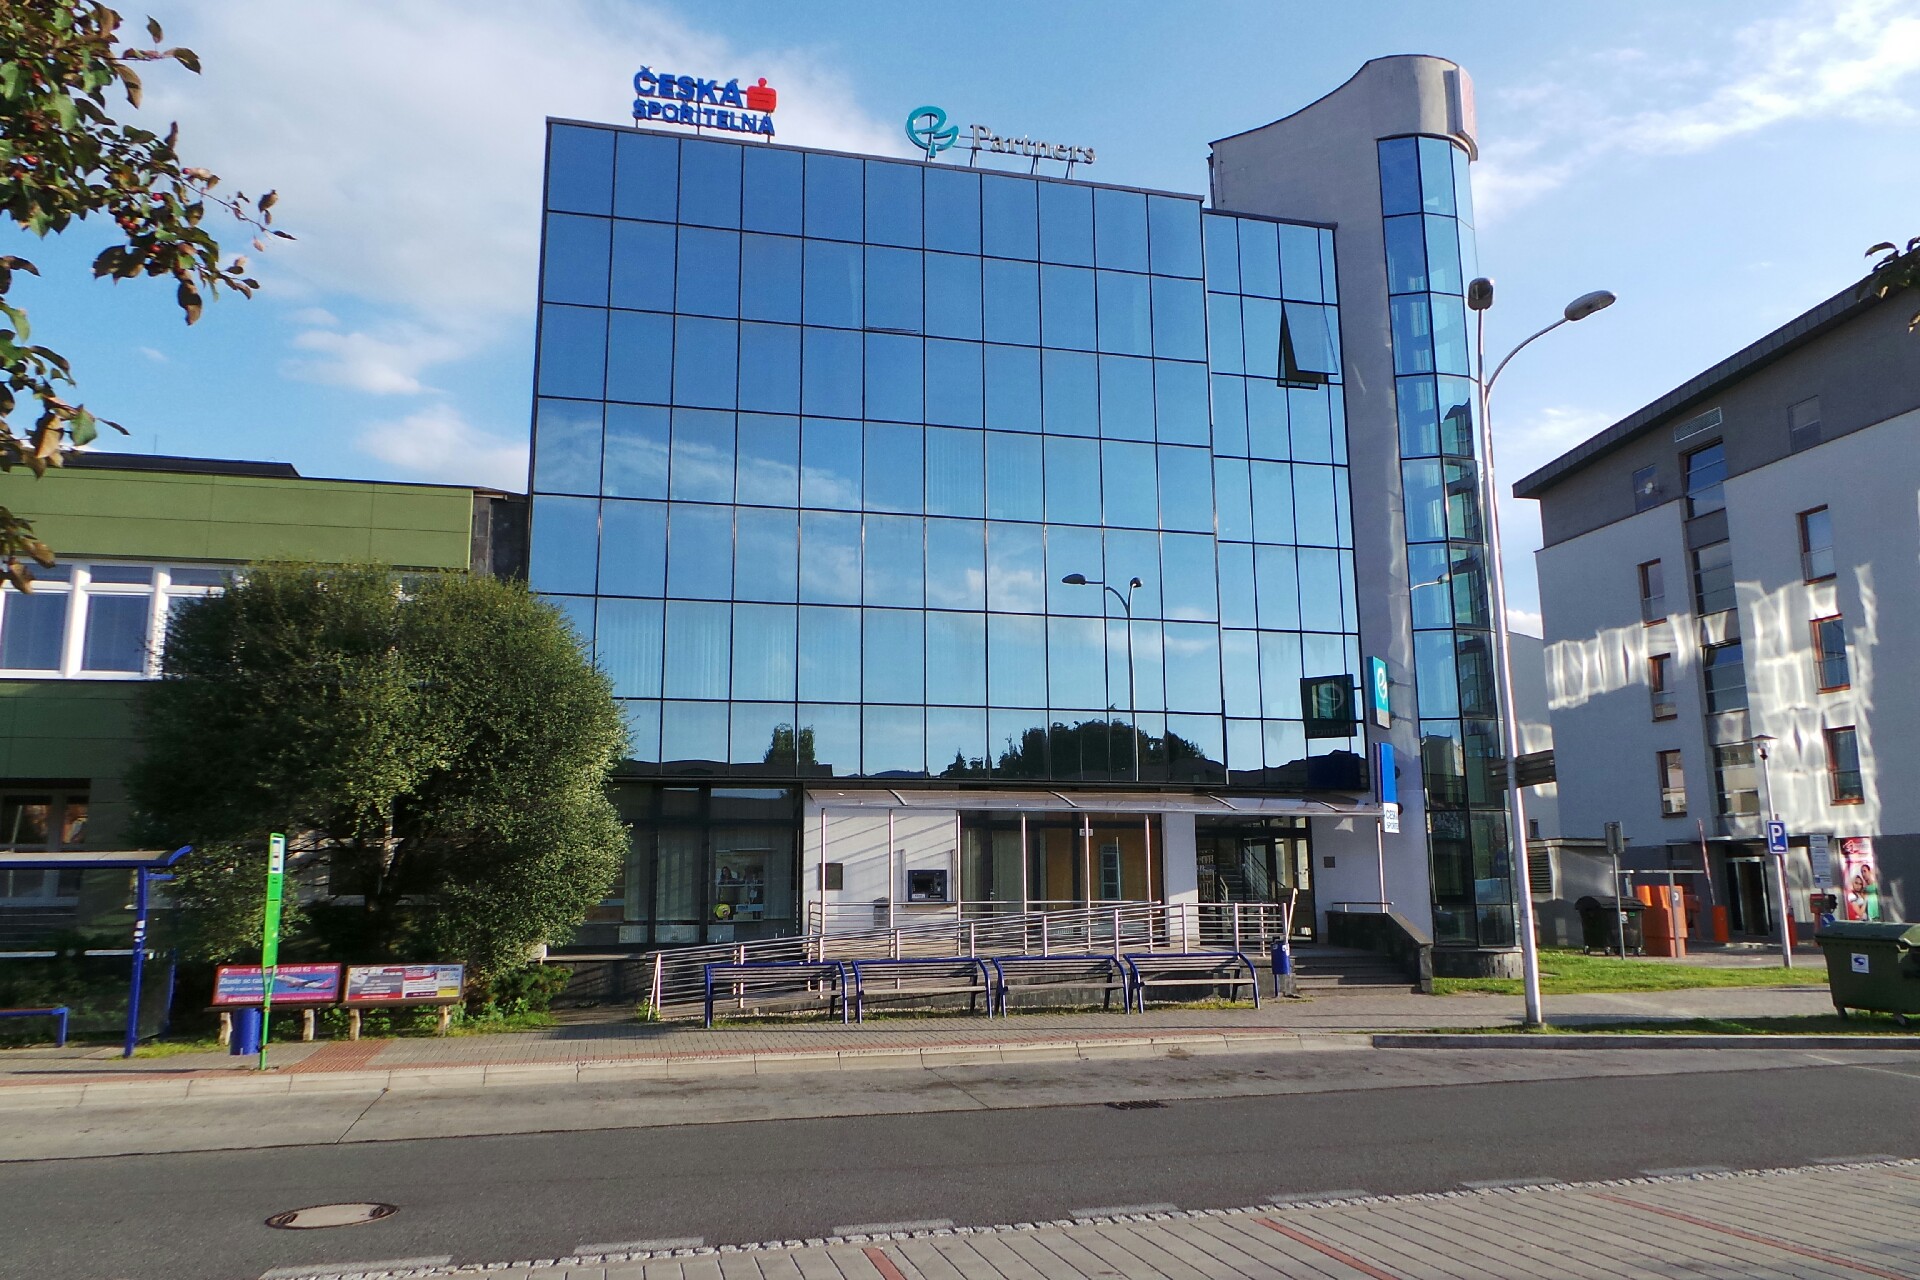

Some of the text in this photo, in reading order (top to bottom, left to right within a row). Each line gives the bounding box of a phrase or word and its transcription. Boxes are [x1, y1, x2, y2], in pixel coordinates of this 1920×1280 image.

[634, 65, 743, 108] ČESKÁ
[633, 99, 775, 136] SPOŘITELNA
[970, 124, 1096, 164] Partners
[1770, 824, 1782, 844] P
